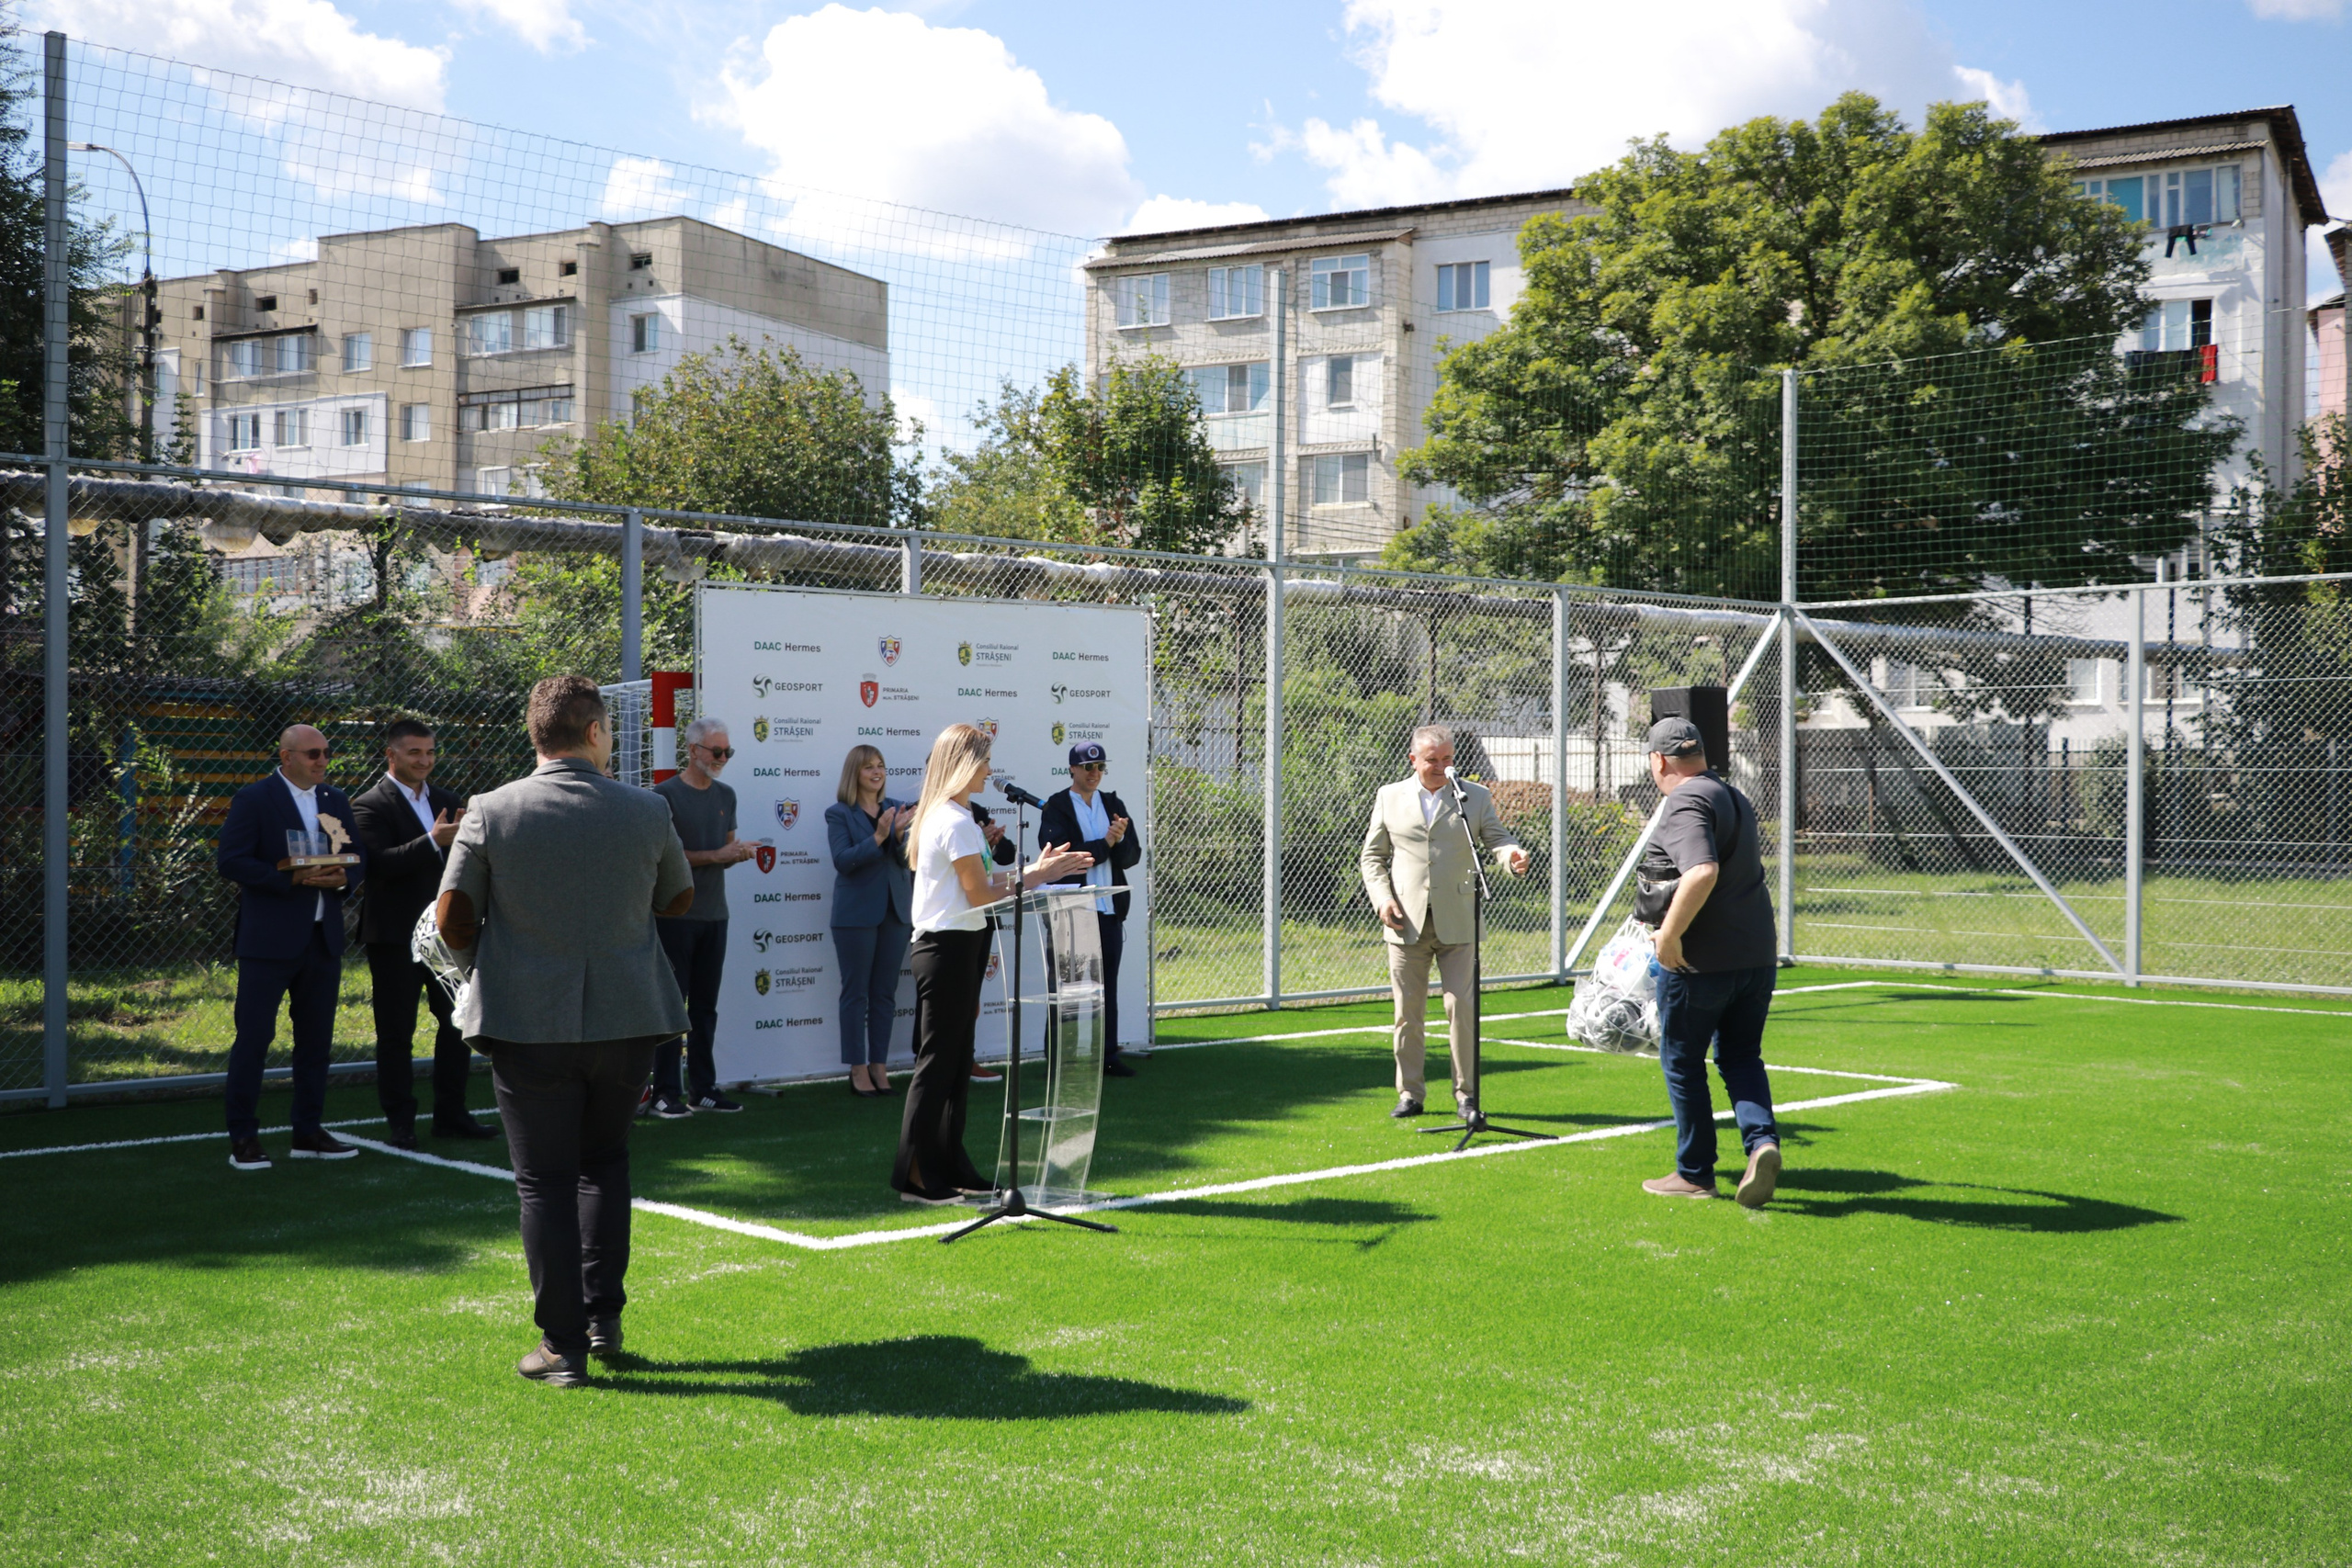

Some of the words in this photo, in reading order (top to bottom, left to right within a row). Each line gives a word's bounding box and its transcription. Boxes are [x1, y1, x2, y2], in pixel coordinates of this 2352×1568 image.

[754, 640, 782, 650] DAAC
[785, 642, 821, 652] Hermes
[1052, 651, 1076, 660] DAAC
[1079, 652, 1109, 661] Hermes
[775, 682, 823, 692] GEOSPORT
[957, 687, 982, 697] DAAC
[985, 688, 1018, 697] Hermes
[1069, 689, 1111, 698] GEOSPORT
[858, 727, 884, 737] DAAC
[887, 728, 921, 737] Hermes
[753, 767, 781, 777] DAAC
[784, 768, 820, 777] Hermes
[885, 767, 923, 776] EOSPORT
[1051, 767, 1070, 775] DAA
[754, 893, 782, 903] DAAC
[785, 892, 821, 902] Hermes
[775, 932, 823, 944] GEOSPORT
[775, 967, 800, 976] Consiliul
[801, 965, 823, 974] Raional
[755, 1019, 784, 1030] DAAC
[786, 1017, 823, 1027] Hermes
